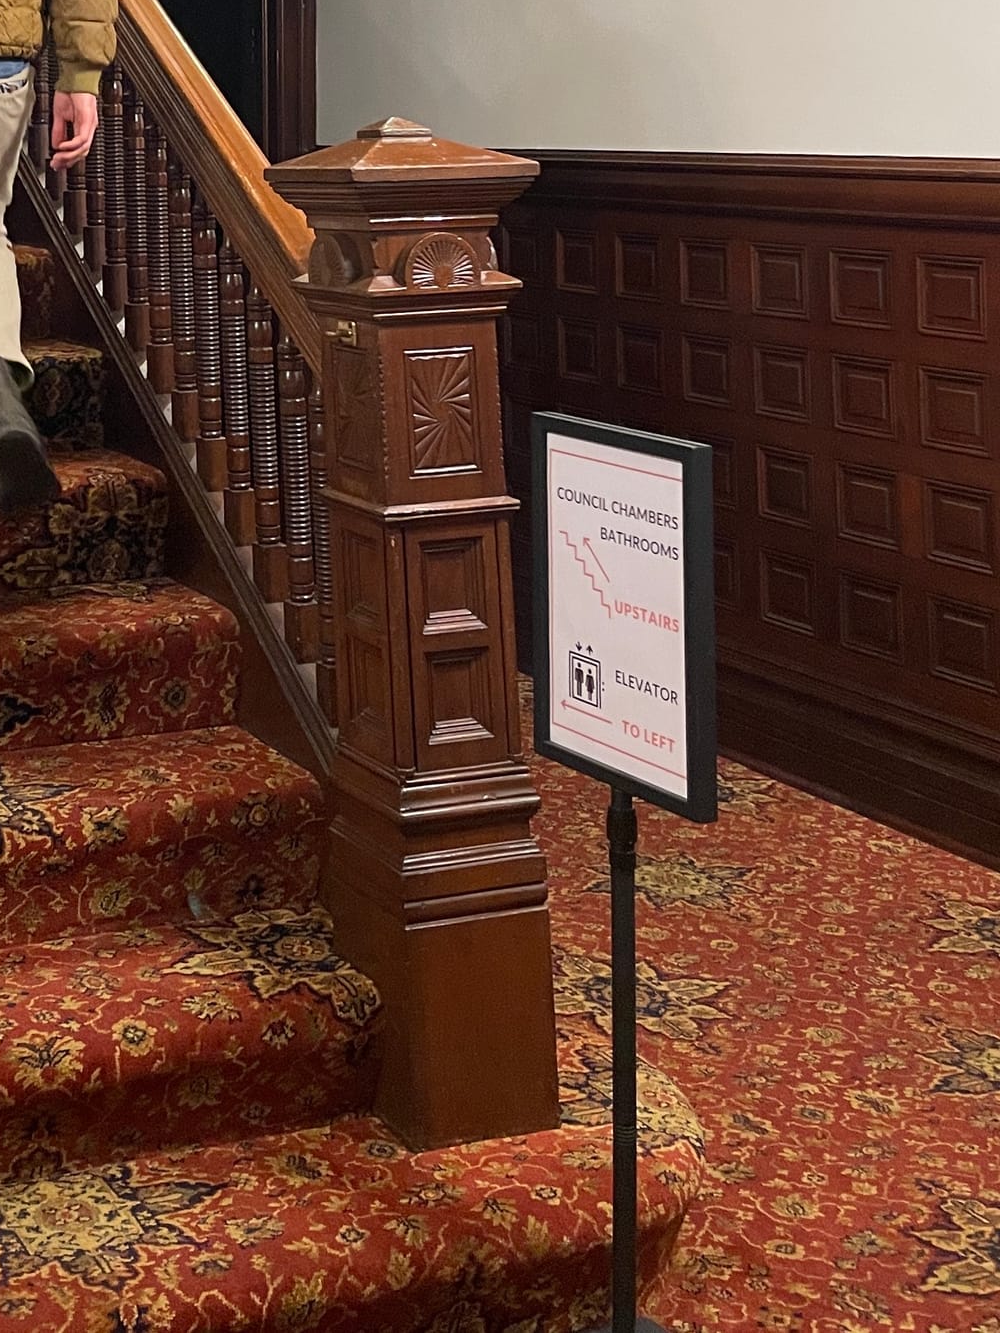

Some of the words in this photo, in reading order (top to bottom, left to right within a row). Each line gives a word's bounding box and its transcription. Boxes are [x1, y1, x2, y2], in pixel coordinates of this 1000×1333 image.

[556, 486, 609, 512] COUNCIL
[611, 500, 679, 530] CHAMBERS
[600, 526, 679, 561] BATHROOMS
[614, 599, 680, 633] UPSTAIRS
[615, 669, 679, 705] ELEVATOR
[622, 720, 640, 739] TO
[644, 728, 675, 753] LEFT
